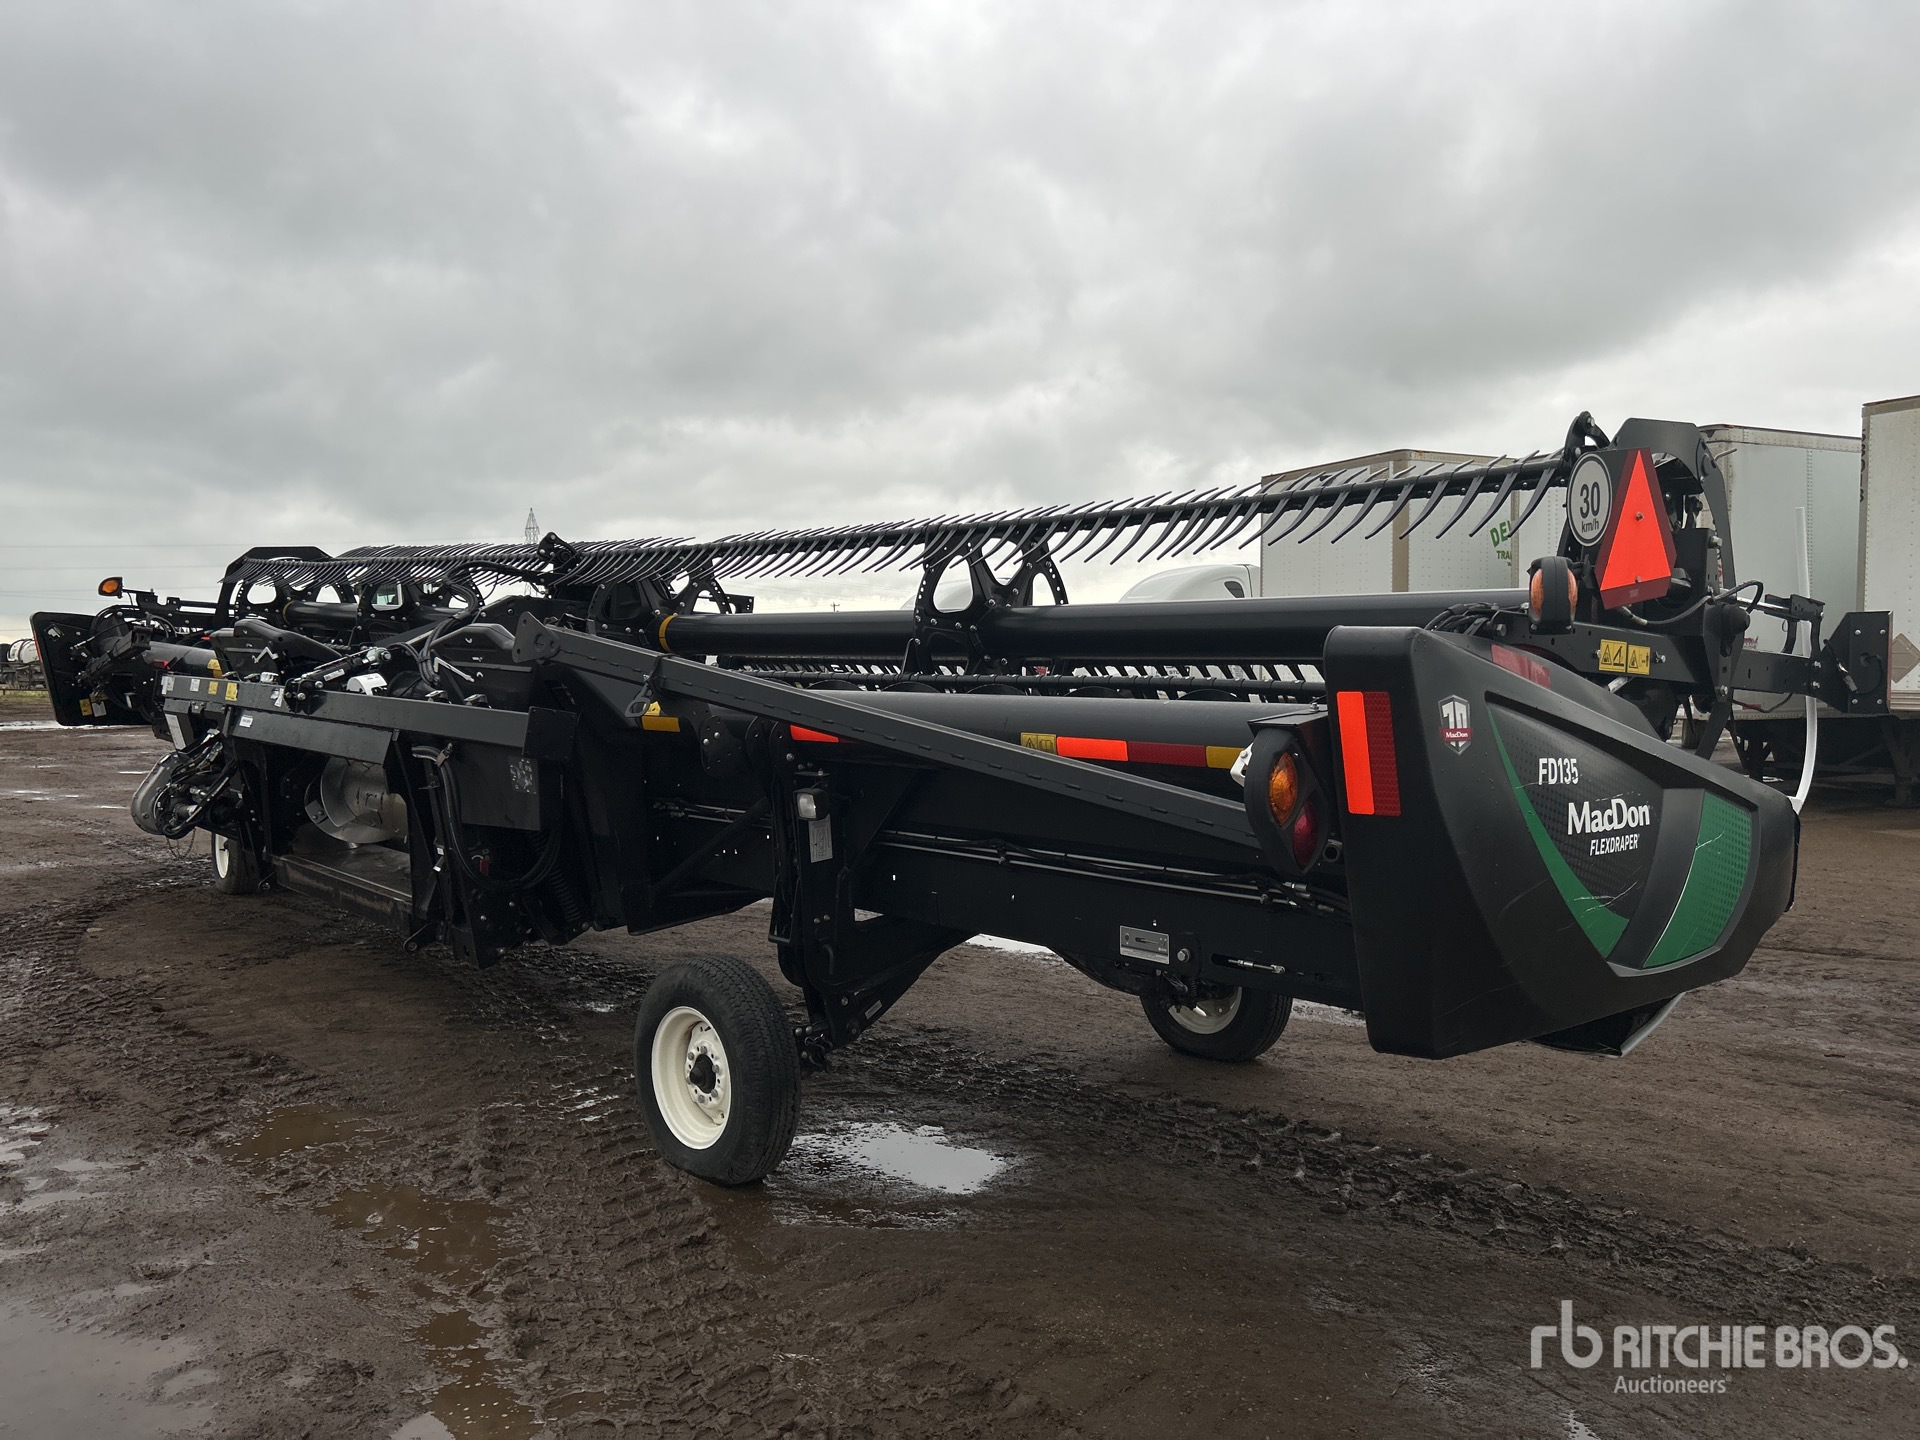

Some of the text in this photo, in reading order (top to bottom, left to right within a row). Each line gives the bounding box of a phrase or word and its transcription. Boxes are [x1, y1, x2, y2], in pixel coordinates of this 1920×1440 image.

[1580, 482, 1600, 518] 30
[1581, 518, 1599, 533] km/h
[1538, 757, 1579, 785] FD135
[1567, 798, 1651, 835] MacDon
[1589, 833, 1639, 856] FLEXDRAPER
